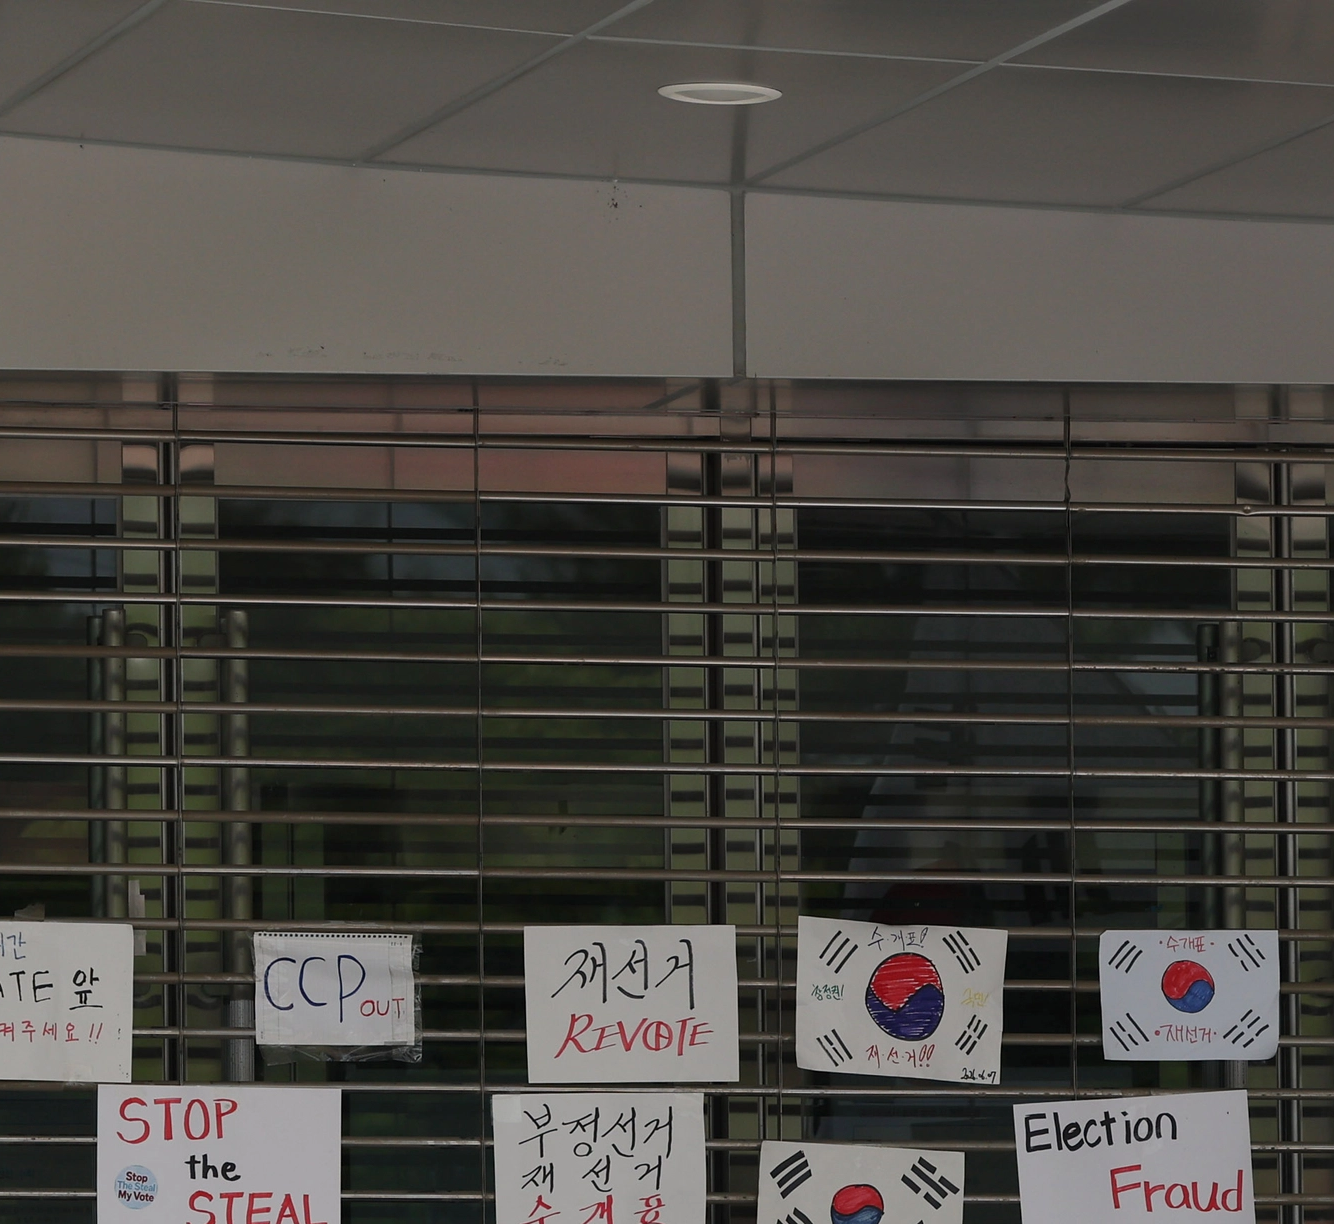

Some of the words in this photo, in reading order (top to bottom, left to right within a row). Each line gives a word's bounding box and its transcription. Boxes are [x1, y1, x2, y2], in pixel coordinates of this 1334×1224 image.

[69, 968, 103, 1011] 앞
[263, 955, 366, 1022] CCP
[359, 998, 405, 1020] OUT
[551, 939, 695, 1011] 재선거
[117, 1097, 239, 1144] STOP
[519, 1104, 674, 1158] 부정선거
[1024, 1112, 1178, 1154] Election
[118, 1180, 133, 1190] The
[134, 1181, 156, 1192] Steal
[126, 1171, 148, 1183] Stop
[184, 1154, 241, 1181] the
[522, 1157, 663, 1194] 재선거
[1109, 1164, 1244, 1213] Fraud
[118, 1190, 132, 1202] My
[134, 1191, 154, 1202] Vote
